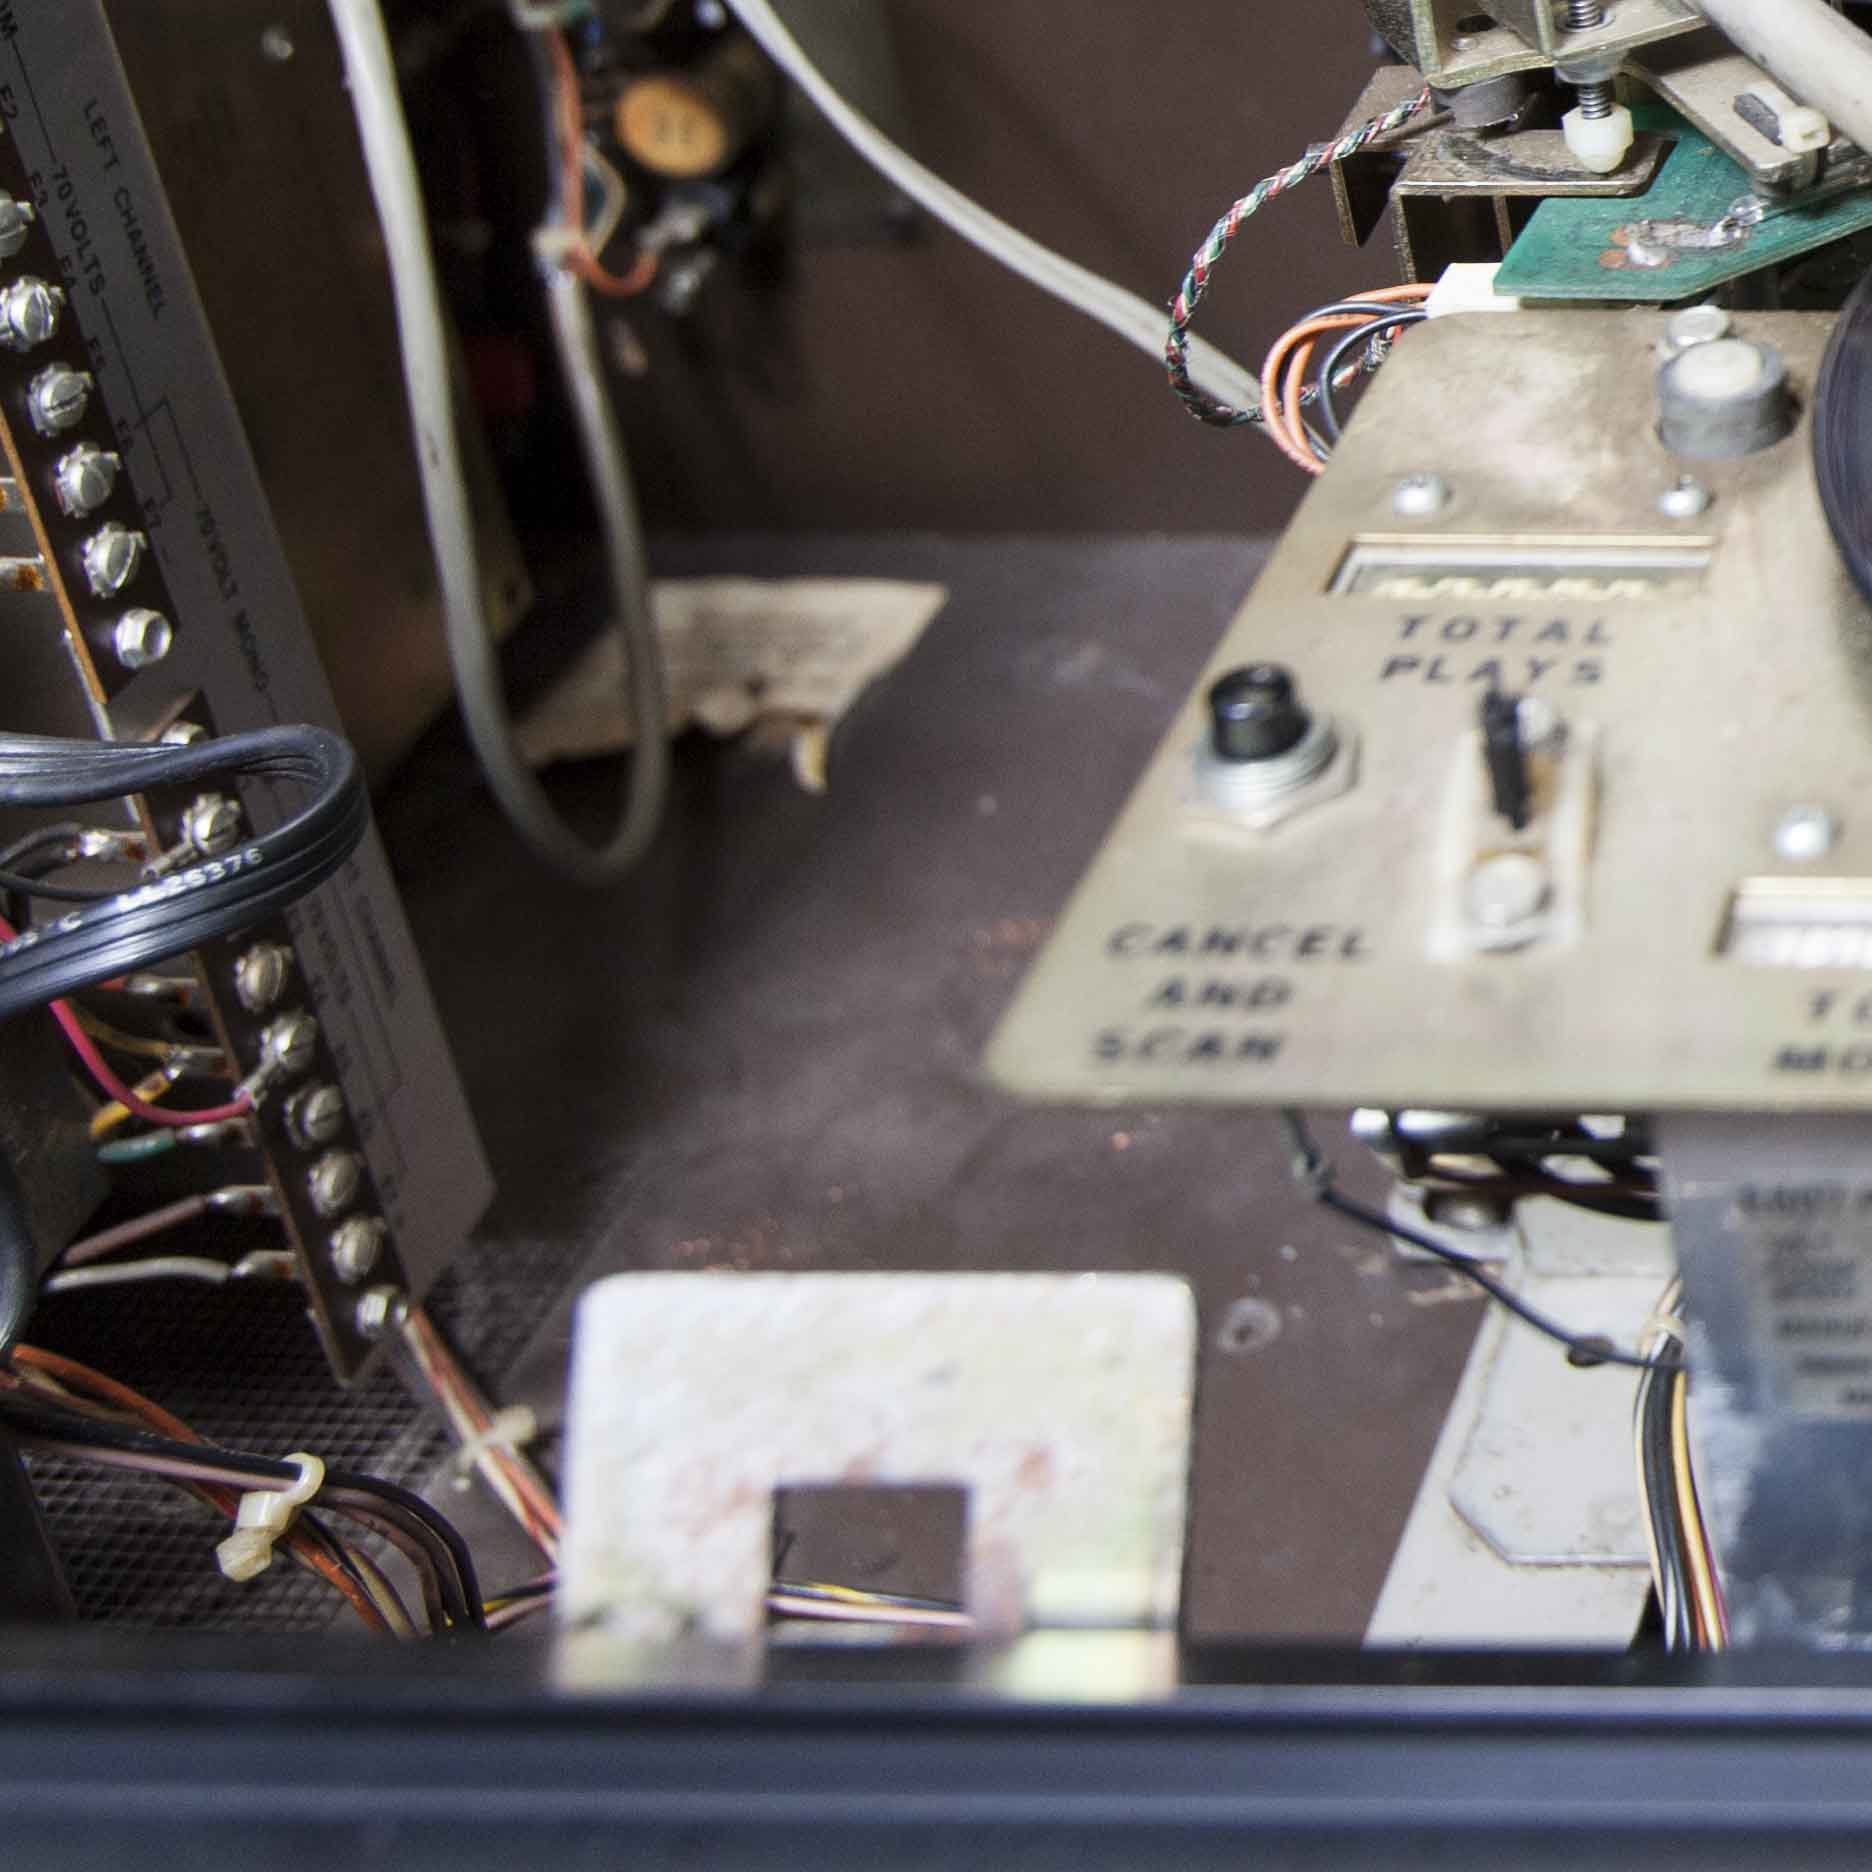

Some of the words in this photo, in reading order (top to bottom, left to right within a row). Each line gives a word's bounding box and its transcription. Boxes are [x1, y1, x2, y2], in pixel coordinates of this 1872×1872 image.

[84, 99, 121, 171] LEFT
[112, 186, 167, 322] CHANNEL
[1400, 613, 1612, 642] TOTAL
[1379, 655, 1604, 683] PLAYS
[1106, 924, 1372, 960] CANCEL
[1148, 979, 1293, 1010] AND
[1093, 1030, 1284, 1064] SCAN
